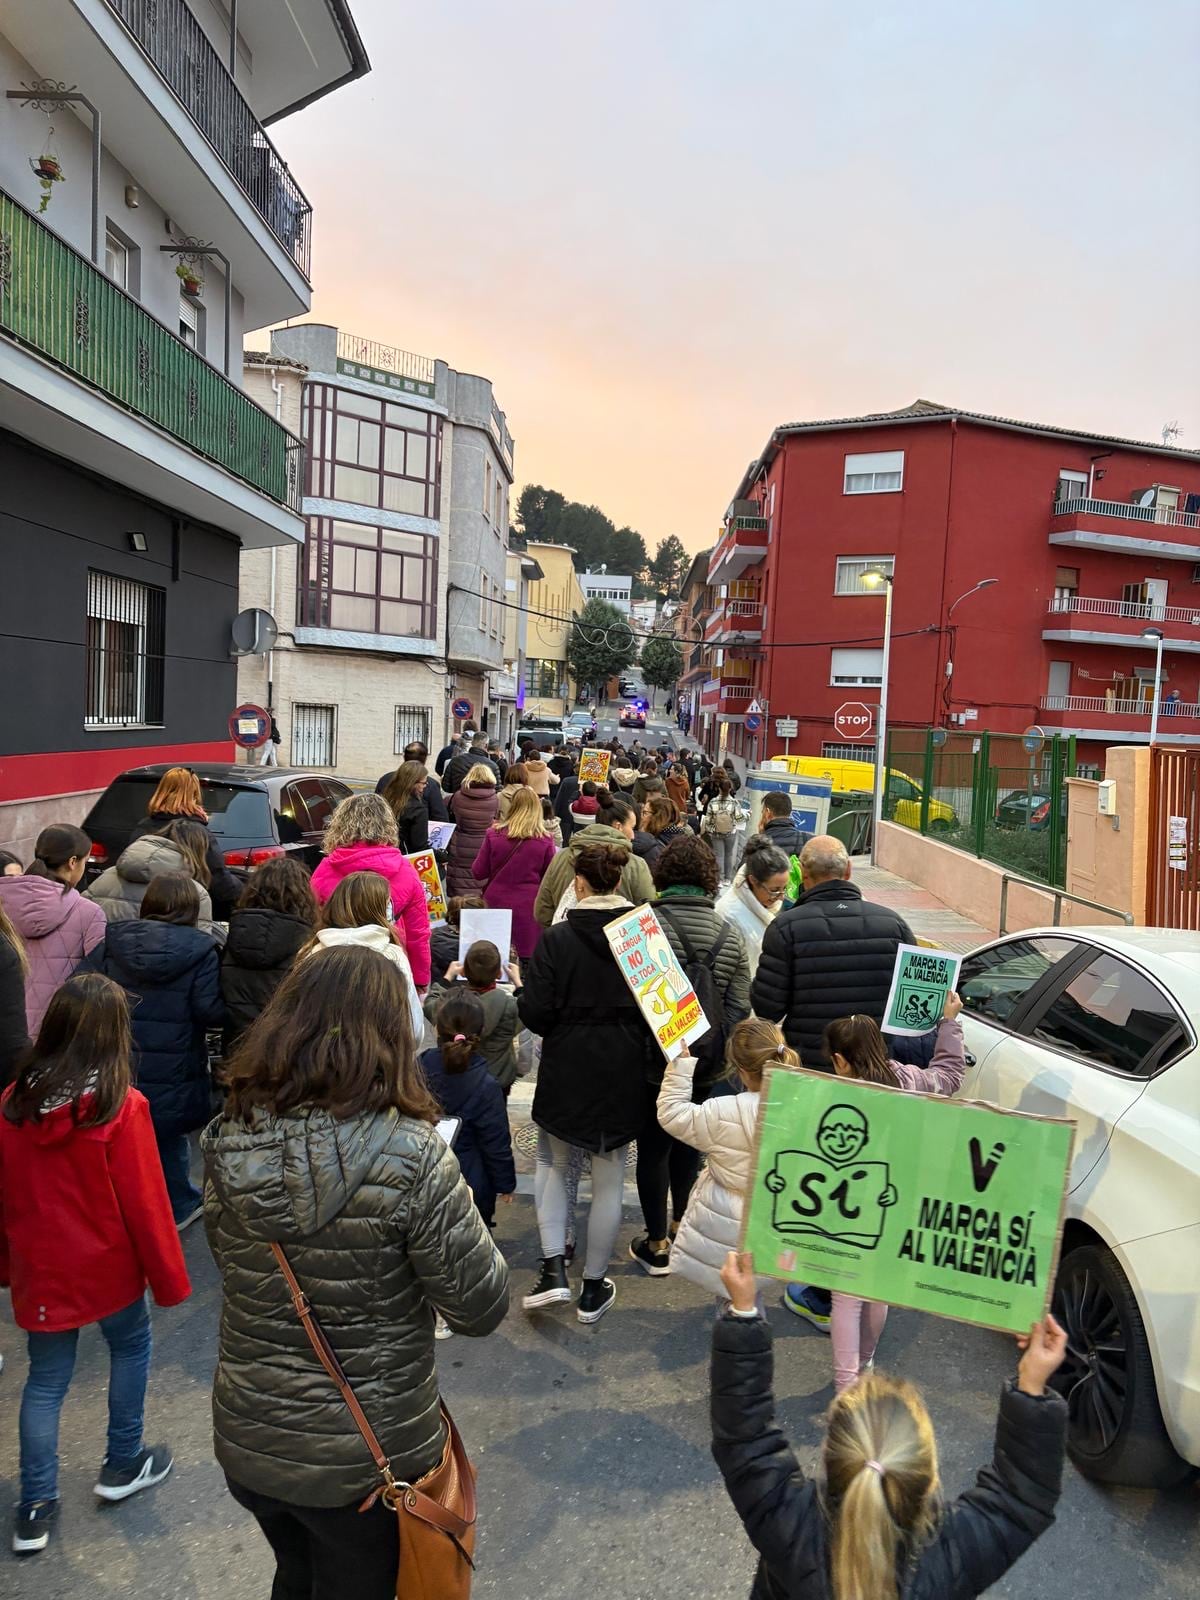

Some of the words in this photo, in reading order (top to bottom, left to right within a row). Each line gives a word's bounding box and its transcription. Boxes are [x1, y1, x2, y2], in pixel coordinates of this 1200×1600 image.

[838, 716, 868, 724] STOP
[618, 927, 628, 938] LA
[616, 934, 642, 955] LLENGUA
[627, 950, 644, 970] NO
[909, 956, 937, 970] MARCA
[938, 959, 948, 972] SÍ
[630, 974, 639, 986] ES
[638, 964, 656, 980] TOCA
[902, 967, 912, 979] AL
[667, 1025, 676, 1039] AL
[918, 1197, 1000, 1243] MARCA
[1007, 1210, 1035, 1250] SÍ
[897, 1229, 925, 1264] AL
[932, 1238, 1037, 1287] VALENCIÀ
